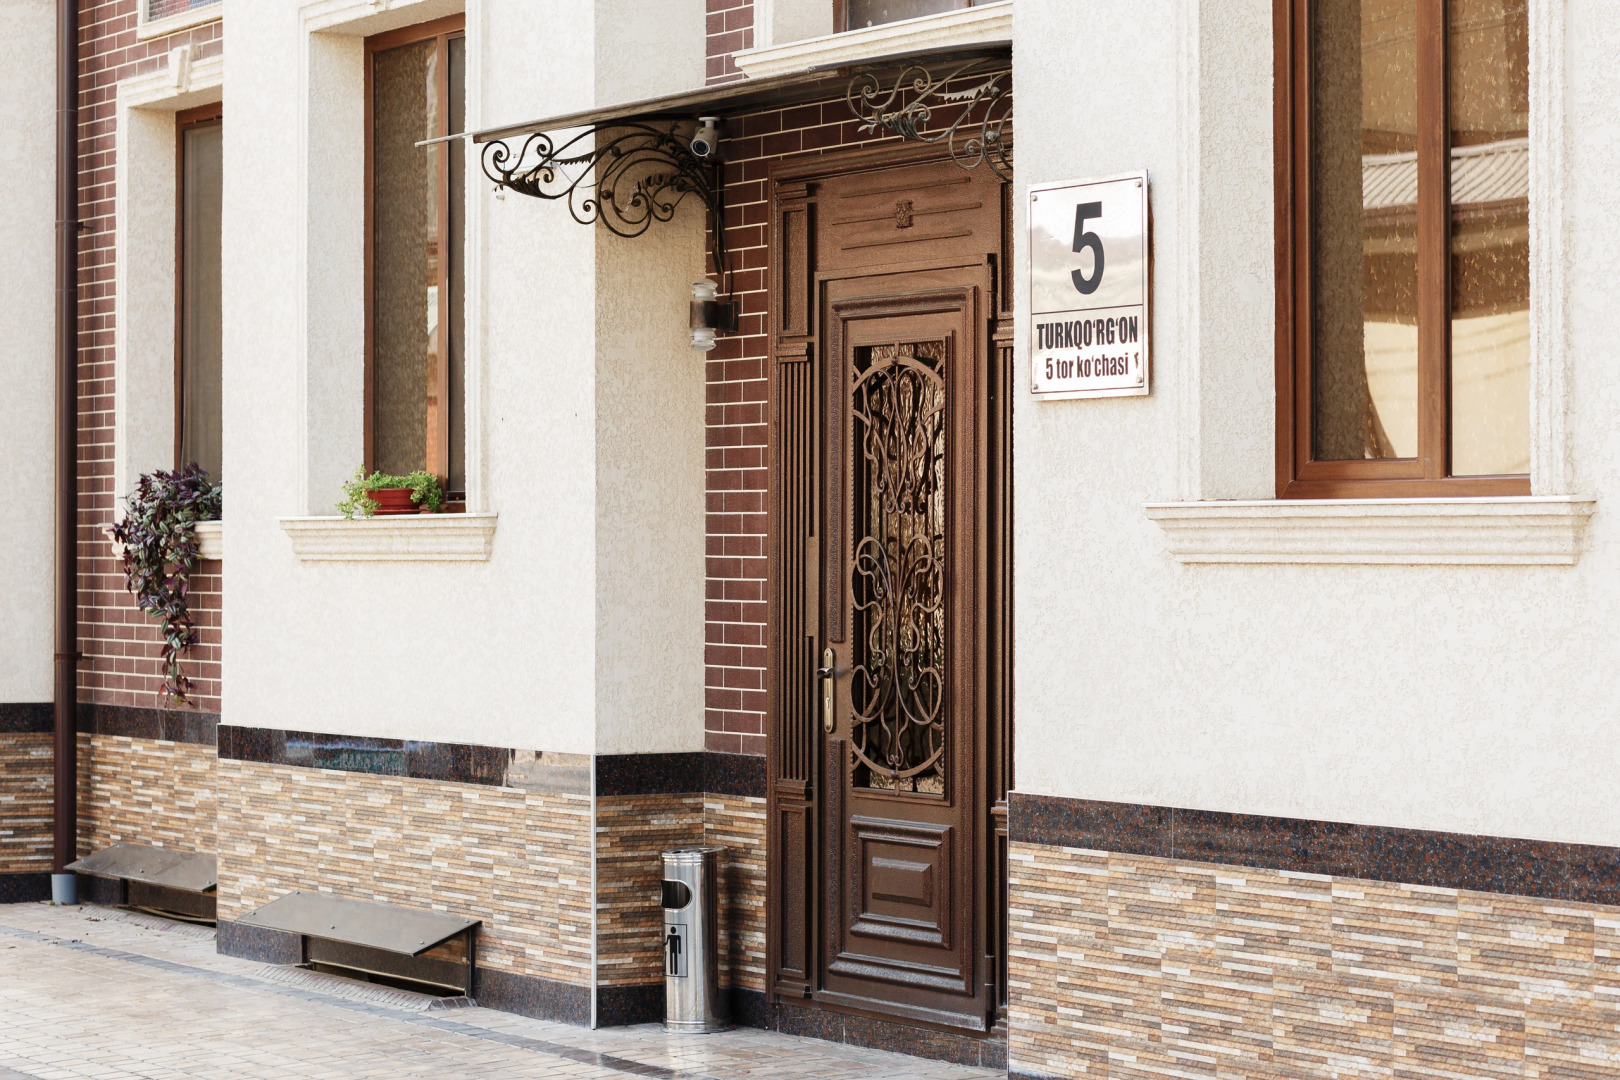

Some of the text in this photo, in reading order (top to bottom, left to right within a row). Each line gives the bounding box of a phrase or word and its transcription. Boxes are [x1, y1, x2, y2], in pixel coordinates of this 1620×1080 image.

[1071, 201, 1105, 295] 5
[1045, 358, 1053, 380] 5
[1056, 359, 1074, 379] tor
